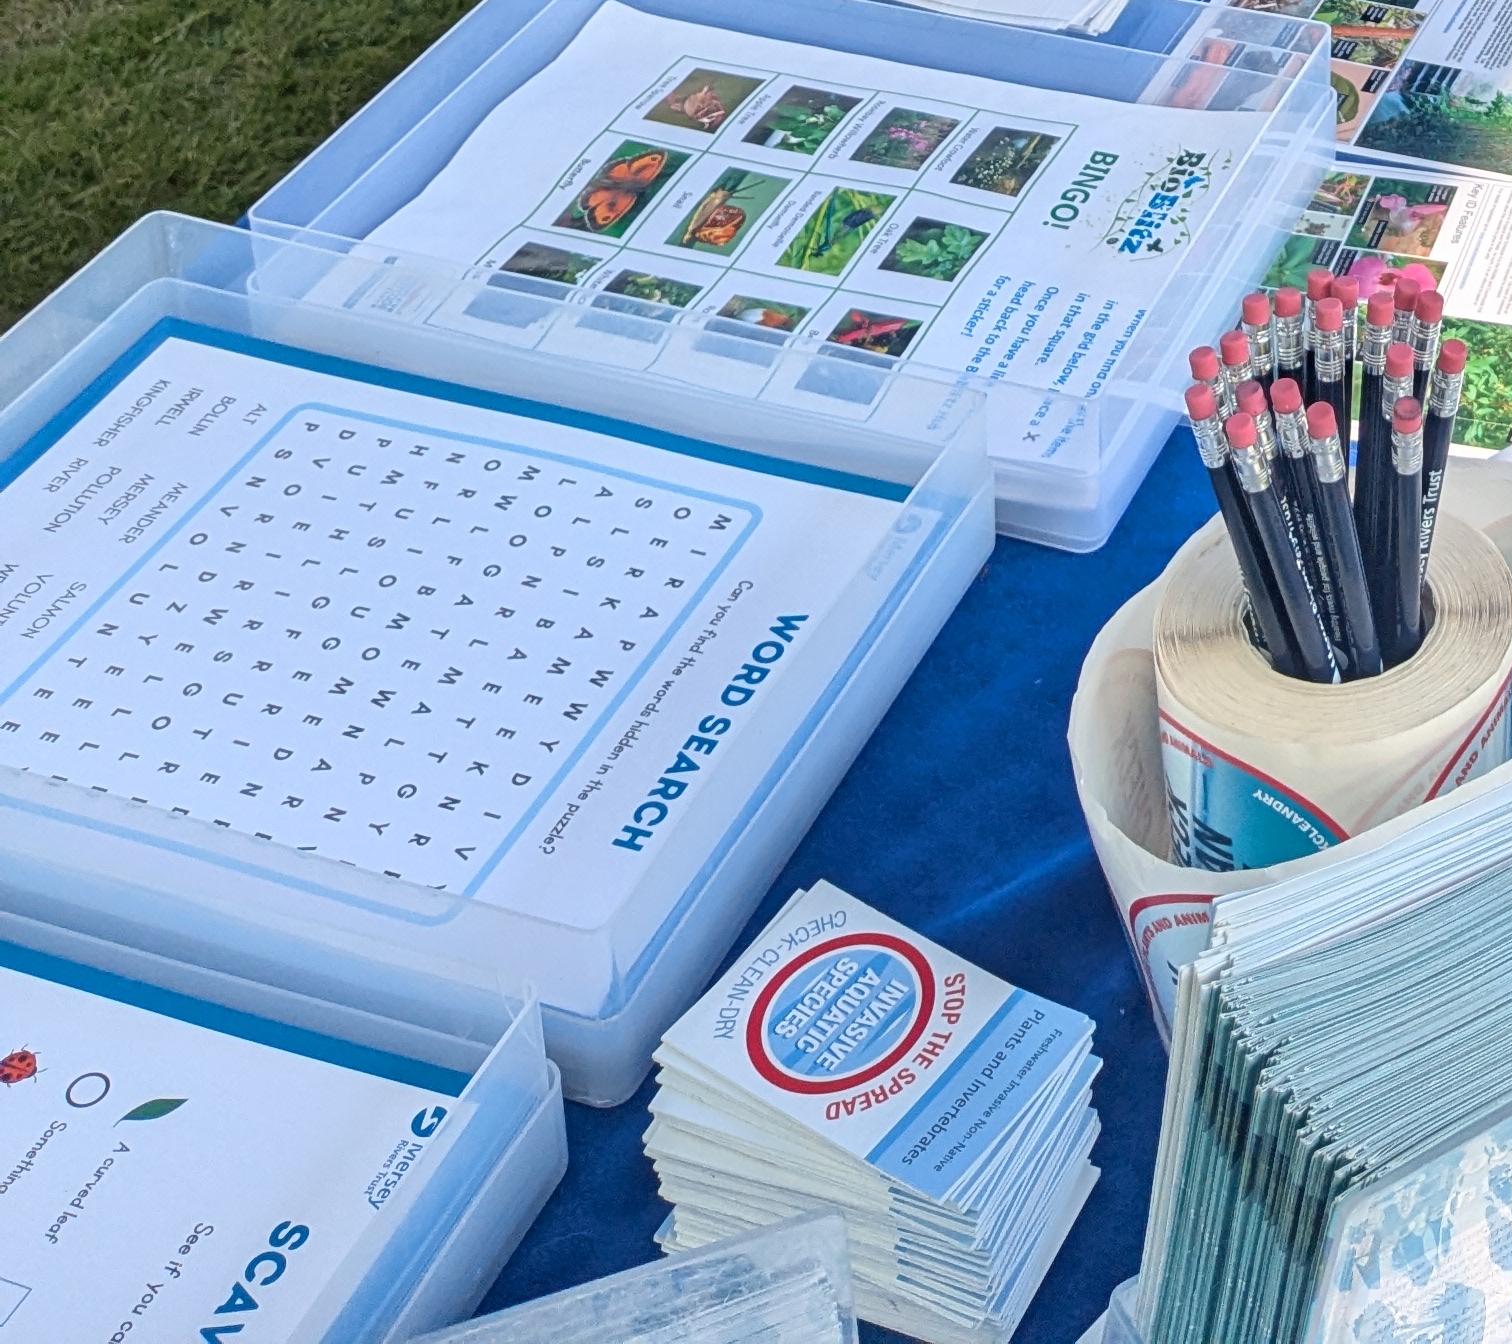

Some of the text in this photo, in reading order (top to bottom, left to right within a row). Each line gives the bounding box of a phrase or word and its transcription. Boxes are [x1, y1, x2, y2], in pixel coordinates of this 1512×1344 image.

[737, 89, 772, 125] Apple Tree
[553, 153, 592, 191] Butterfly
[672, 191, 693, 209] Snail
[1042, 150, 1118, 230] BINGO!
[1118, 147, 1206, 258] BioBlitz
[1466, 182, 1483, 198] Key
[870, 219, 900, 255] Oak Tree
[1449, 209, 1473, 245] Features
[960, 275, 1012, 338] for a sticker!
[971, 280, 1037, 364] head back to the
[997, 286, 1060, 369] Once you have a
[1034, 292, 1091, 366] in that square.
[1090, 312, 1110, 331] the
[1102, 299, 1119, 311] in
[1052, 351, 1087, 386] below,
[1076, 331, 1097, 351] grid
[1109, 339, 1129, 357] you
[92, 379, 171, 447] KINGFISHER
[154, 387, 204, 426] IRWELL
[187, 395, 237, 437] BOLLIN
[242, 403, 268, 426] ALT
[42, 457, 89, 493] RIVER
[42, 466, 123, 533] POLLUTION
[97, 473, 156, 526] MERSEY
[1419, 465, 1443, 549] Rivers Trust
[118, 482, 189, 544] MEANDER
[20, 581, 88, 639] SALMON
[538, 580, 754, 855] Can you find the words hidden in the puzzle?
[611, 614, 810, 852] WORD SEARCH
[714, 909, 848, 1040] CHECK-CLEAN-DRY
[774, 957, 859, 1040] SPECIES
[796, 968, 883, 1055] AQUATIC
[819, 979, 909, 1072] INVASIVE
[825, 971, 966, 1121] STOP THE SPREAD
[901, 1009, 1046, 1166] Plants and Invertebrates
[933, 1028, 1063, 1172] Freshwater Invasive Non-Native
[44, 1141, 131, 1245] A curved leaf
[363, 1139, 410, 1200] Rivers Trust
[367, 1141, 424, 1211] Mersey
[131, 1222, 215, 1316] See if you
